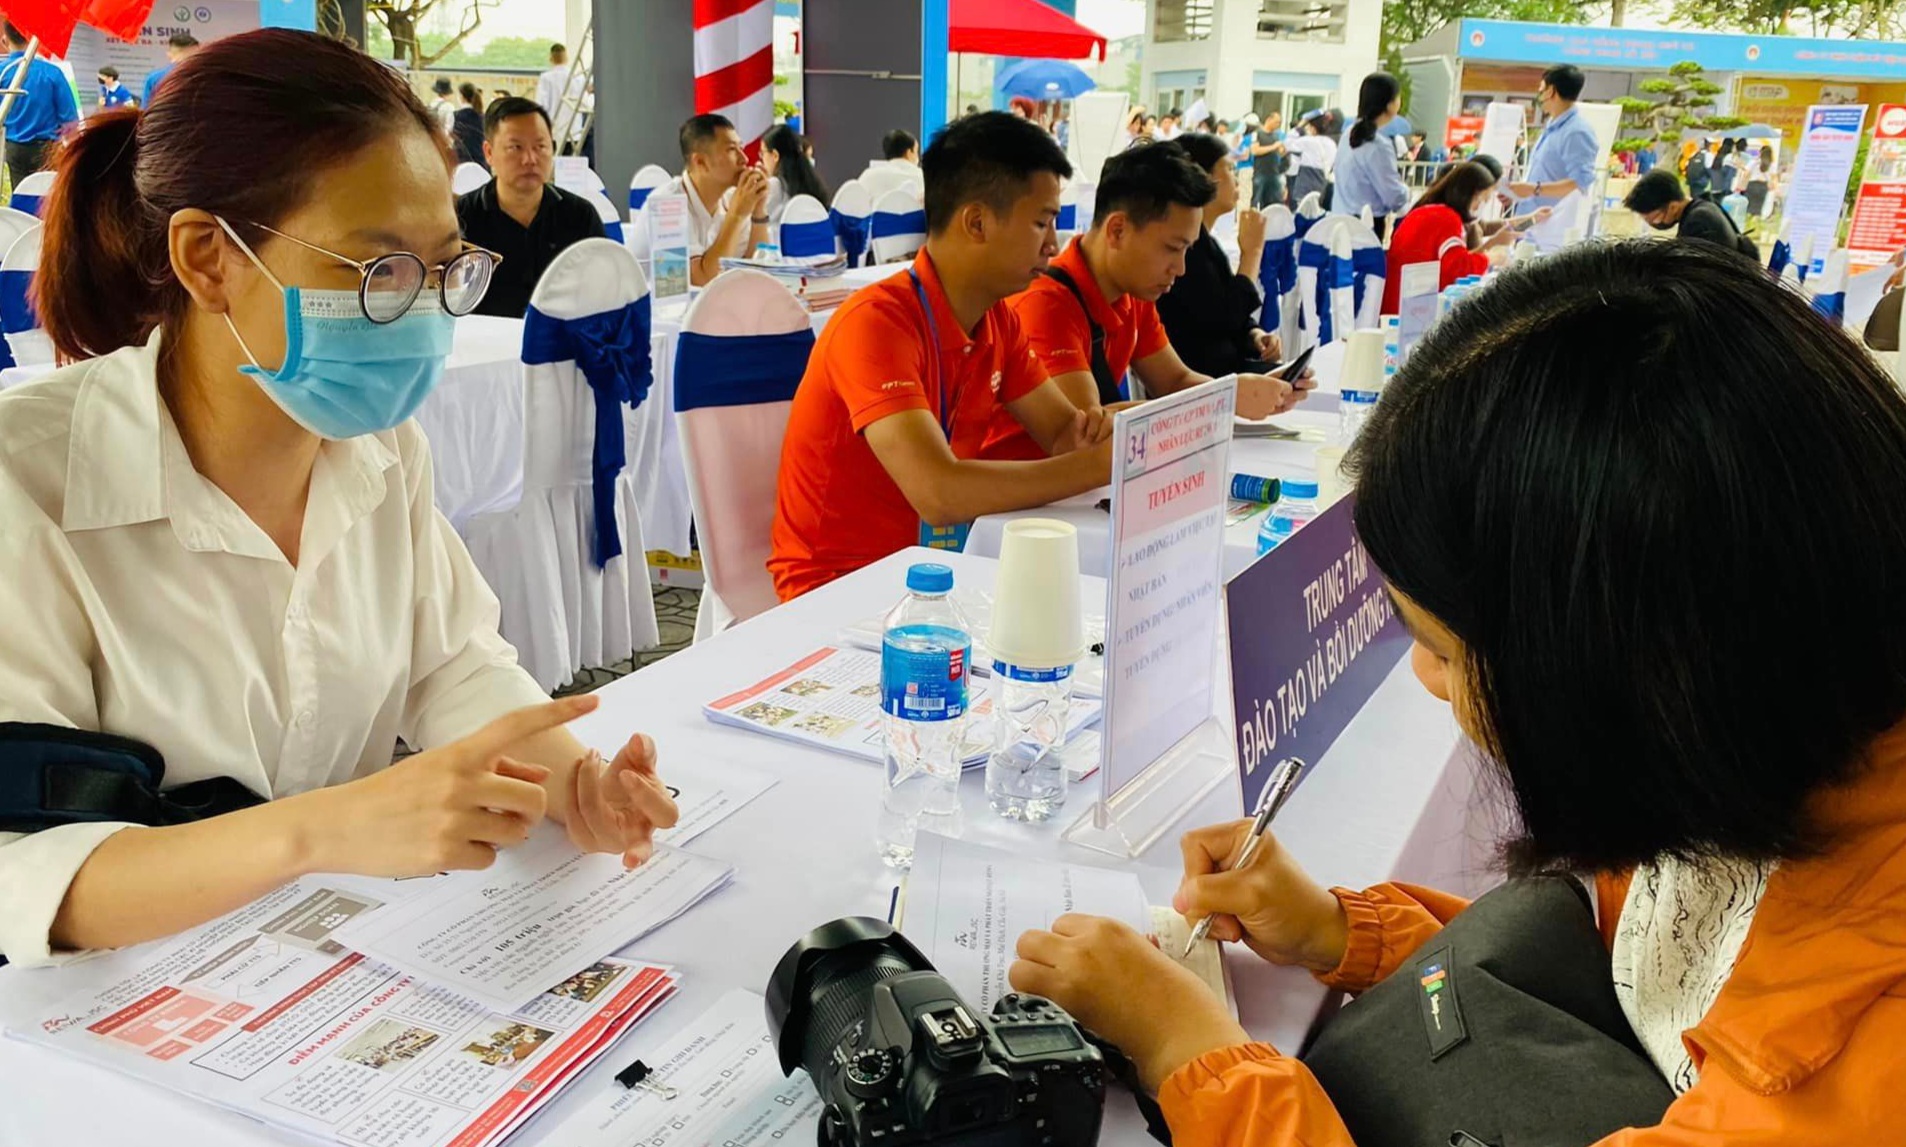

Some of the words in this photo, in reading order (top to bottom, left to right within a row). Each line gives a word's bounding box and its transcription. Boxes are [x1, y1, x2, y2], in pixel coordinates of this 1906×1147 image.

[1127, 431, 1146, 464] 34
[1182, 470, 1205, 494] SINH
[1303, 556, 1345, 634] TRUNG
[1344, 535, 1369, 594] TÂM
[1242, 698, 1277, 776] ĐÀO
[1277, 666, 1308, 738] TẠO
[1307, 638, 1328, 703] VÀ
[1326, 619, 1349, 685] BỒI
[1347, 588, 1385, 663] DƯỠNG
[495, 939, 514, 951] 105
[515, 924, 541, 939] triệu
[288, 1045, 318, 1065] ĐIỂM
[316, 1021, 350, 1045] MẠNH
[348, 1007, 372, 1022] CỦA
[371, 986, 400, 1006] CÔNG
[397, 978, 410, 987] TY
[684, 1036, 705, 1052] DANH
